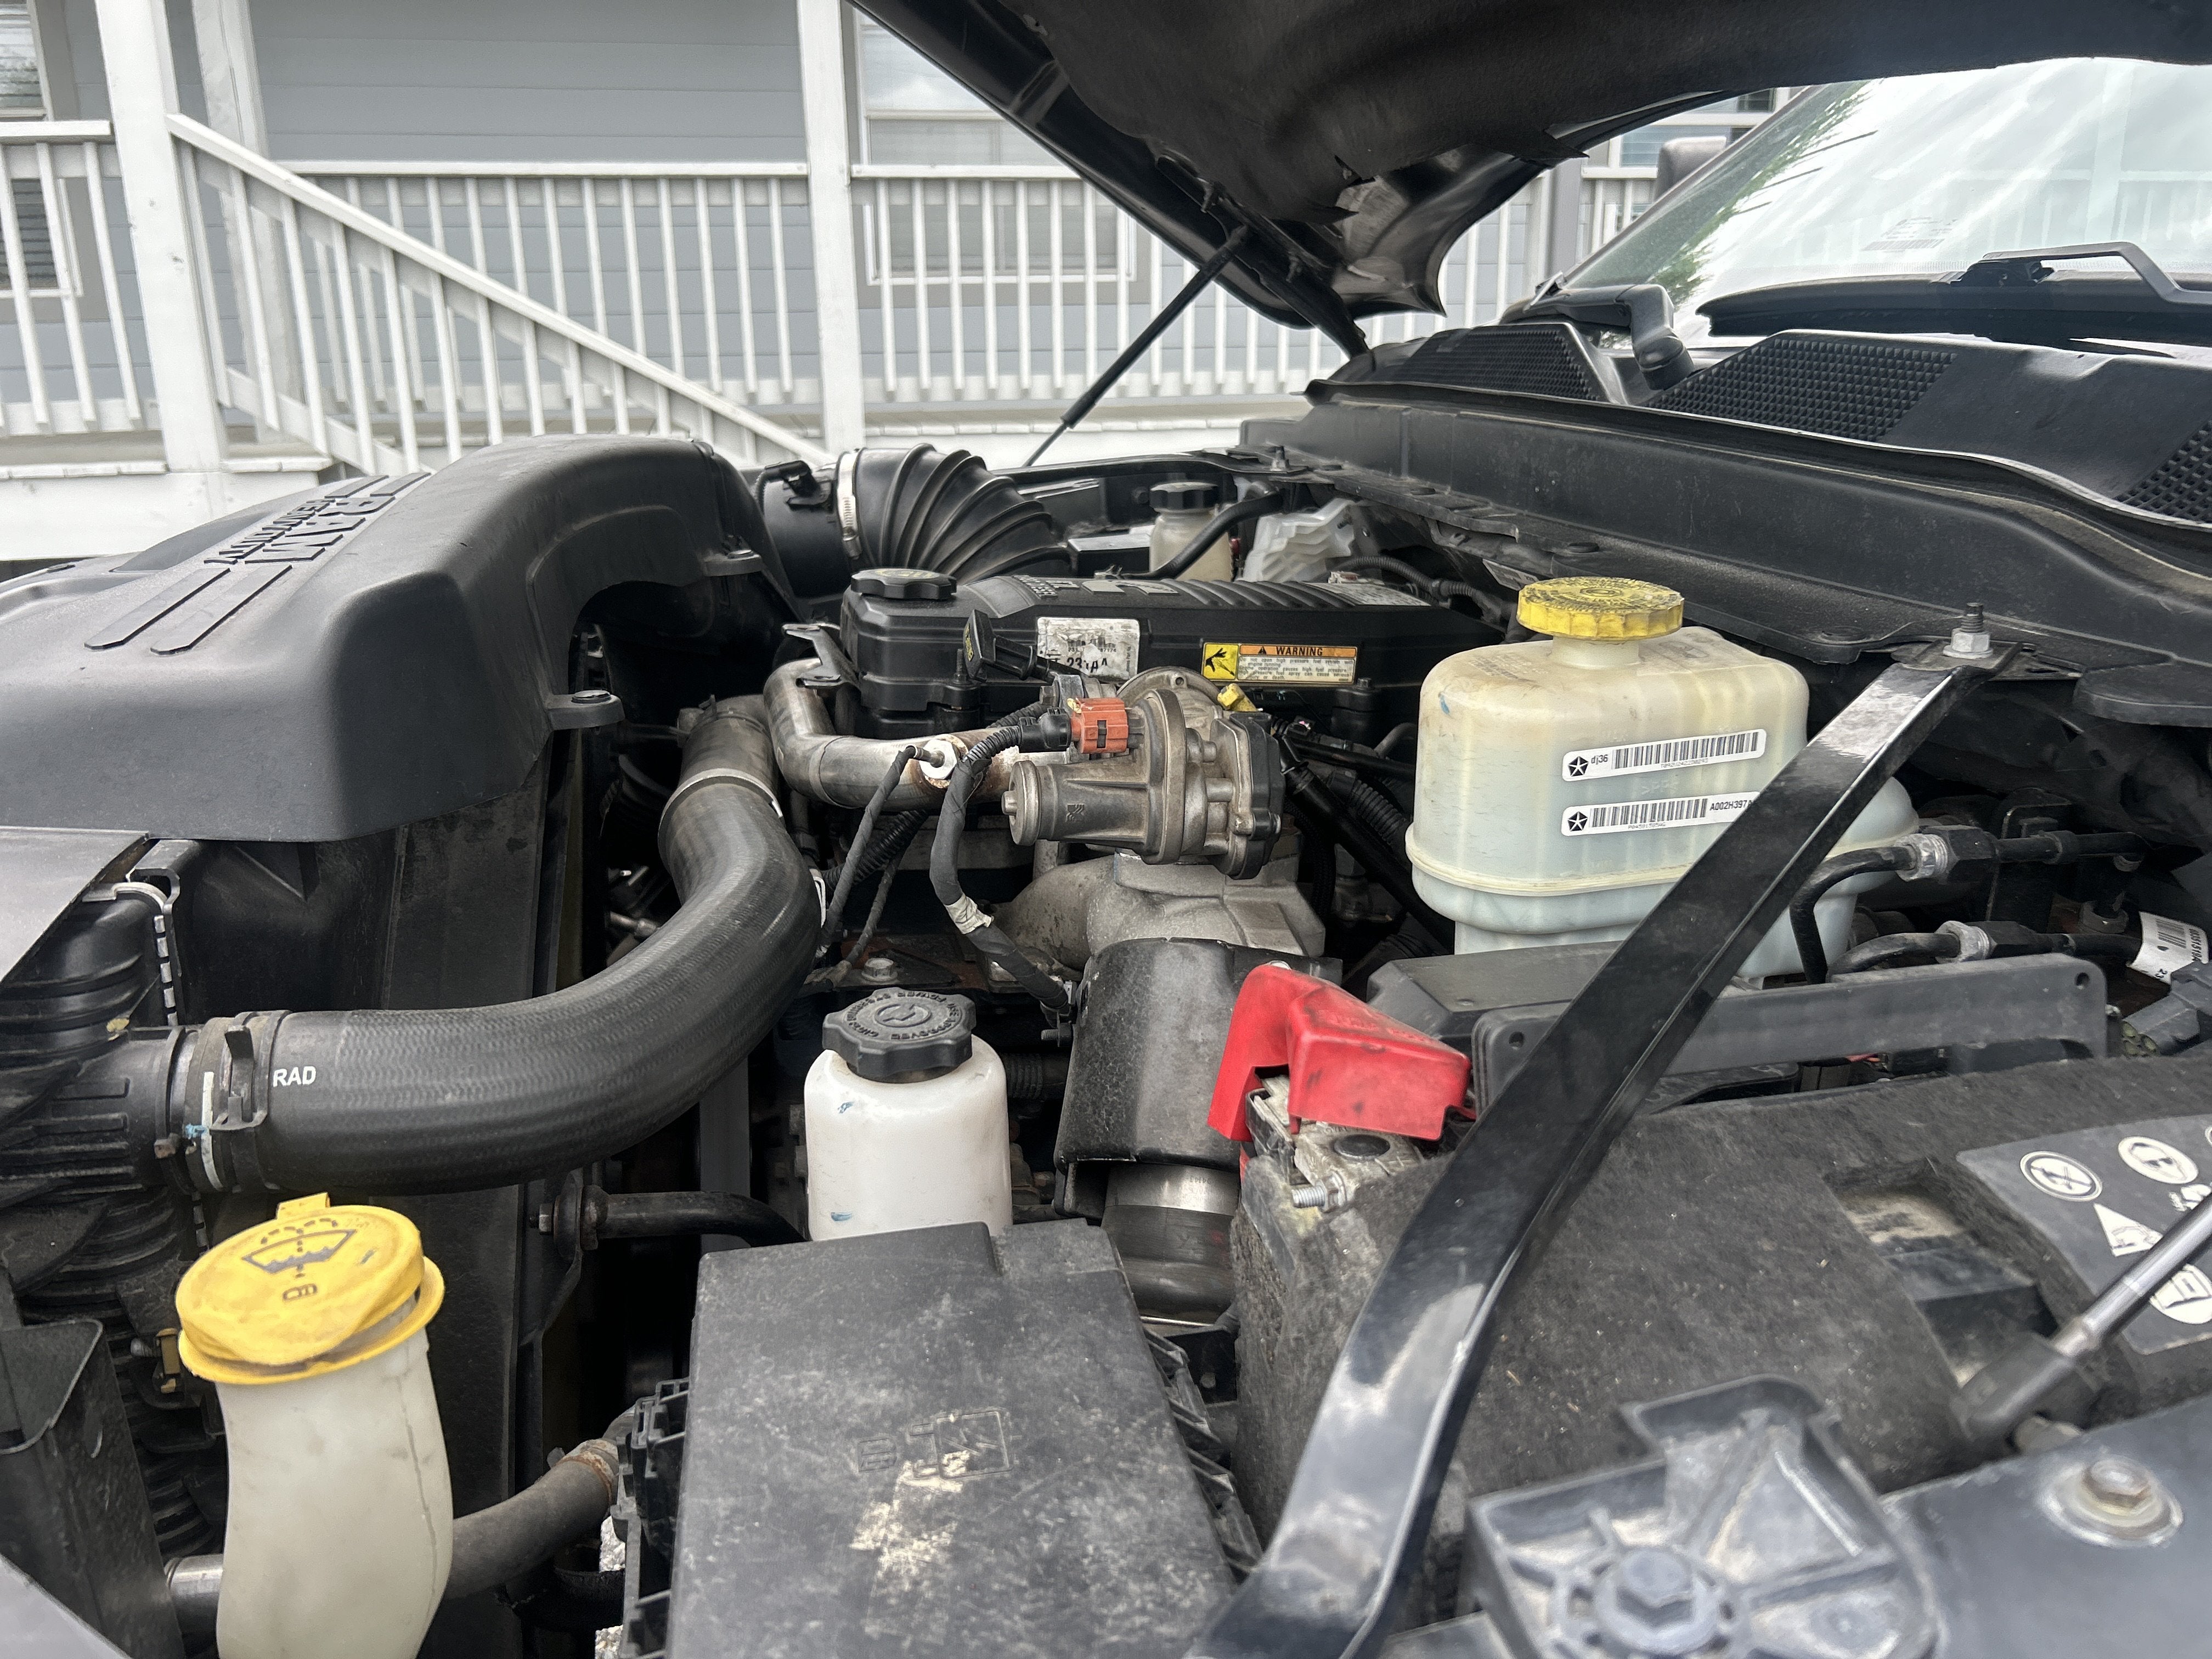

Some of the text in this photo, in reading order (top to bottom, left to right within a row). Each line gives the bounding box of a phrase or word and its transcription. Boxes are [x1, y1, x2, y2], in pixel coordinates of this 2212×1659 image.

[245, 496, 395, 563] RAM
[204, 531, 285, 565] DUTY
[1276, 646, 1323, 657] WARNING
[1591, 754, 1609, 765] dj36
[898, 991, 947, 1003] POWER
[273, 1066, 317, 1087] RAD
